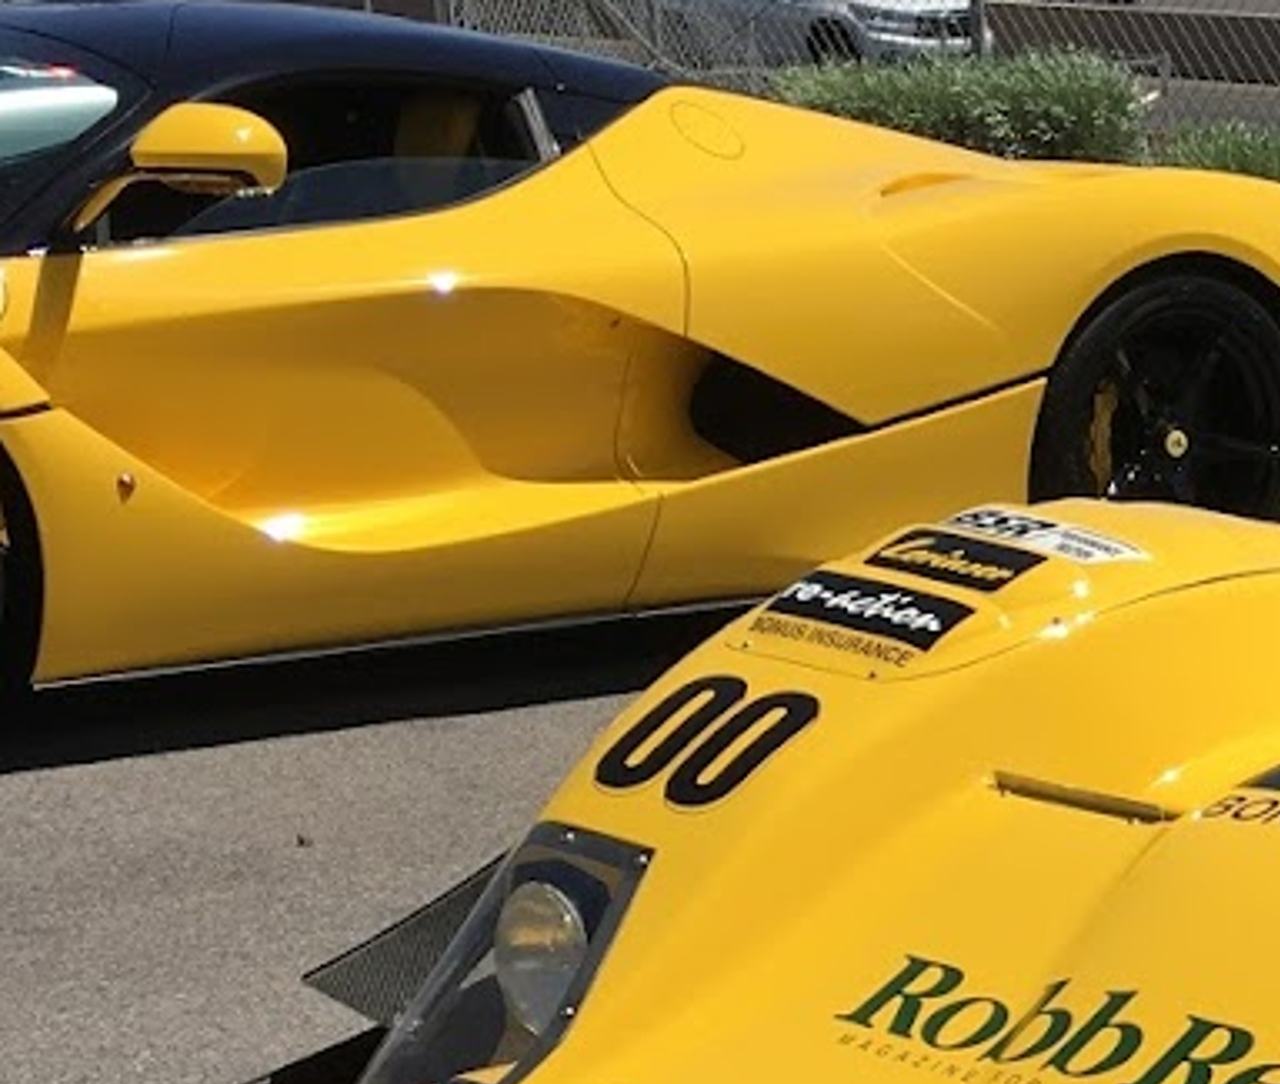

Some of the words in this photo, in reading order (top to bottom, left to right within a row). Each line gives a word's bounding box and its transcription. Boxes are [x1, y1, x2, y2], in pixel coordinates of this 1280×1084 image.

[749, 616, 806, 641] BONUS
[807, 627, 915, 669] INSURANCE
[593, 675, 821, 807] 00
[834, 953, 1144, 1078] Robb
[838, 1032, 980, 1083] MAGAZINE
